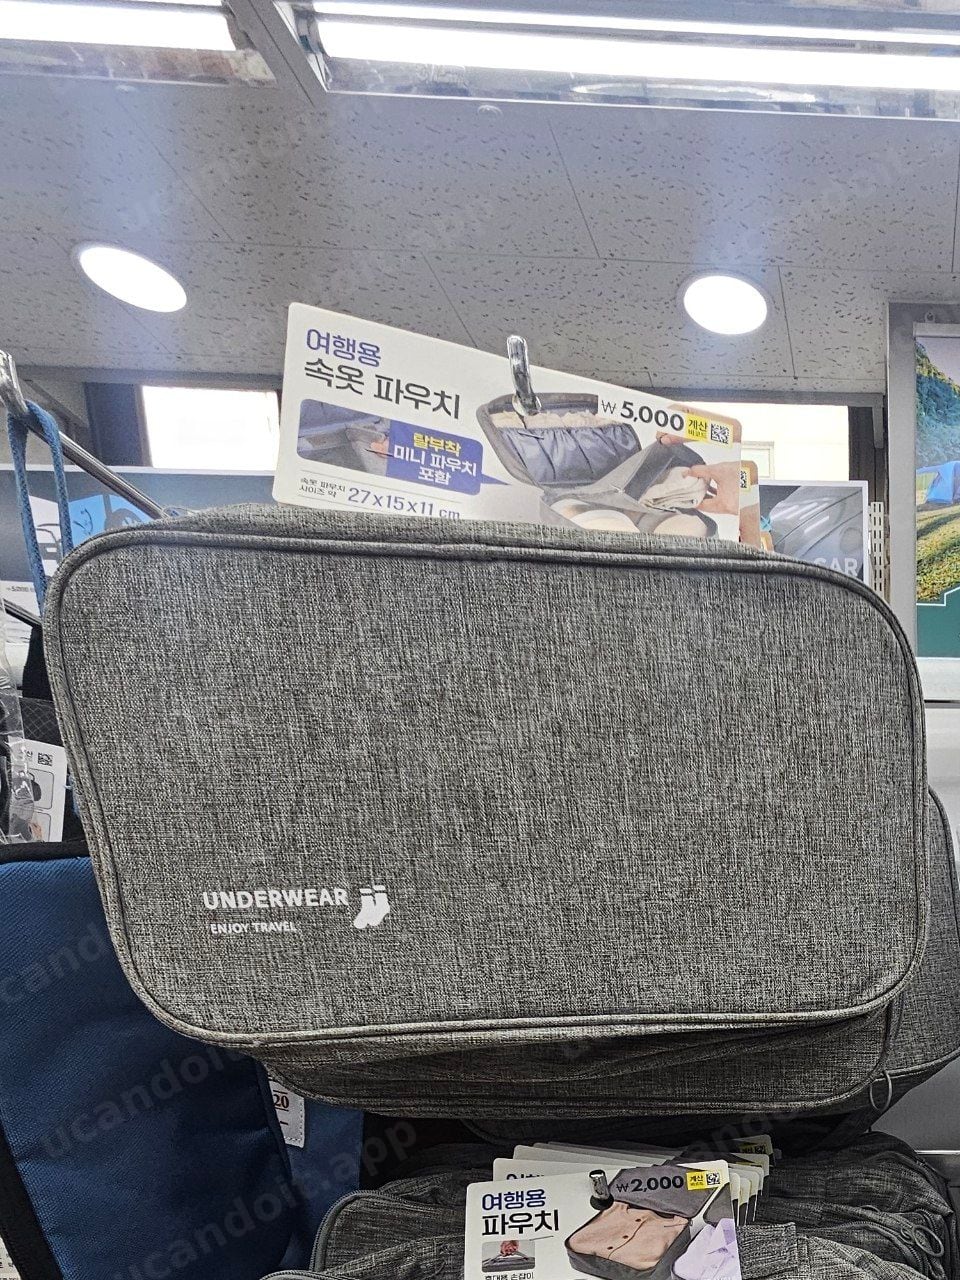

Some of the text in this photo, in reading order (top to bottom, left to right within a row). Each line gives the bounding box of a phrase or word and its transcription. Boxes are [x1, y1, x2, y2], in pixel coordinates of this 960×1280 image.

[306, 329, 381, 367] 여행용
[304, 358, 460, 419] 속옷 파우치
[688, 419, 708, 432] 계산
[413, 432, 461, 457] 탈부착
[394, 444, 477, 476] 미니 파우치
[418, 468, 451, 486] 포함
[438, 508, 460, 520] cm
[202, 888, 349, 909] UNDERWEAR
[210, 922, 297, 934] ENJOY TRAVEL
[482, 1189, 546, 1211] 여행용
[482, 1209, 559, 1236] 파우치
[511, 1272, 533, 1280] 손잡이
